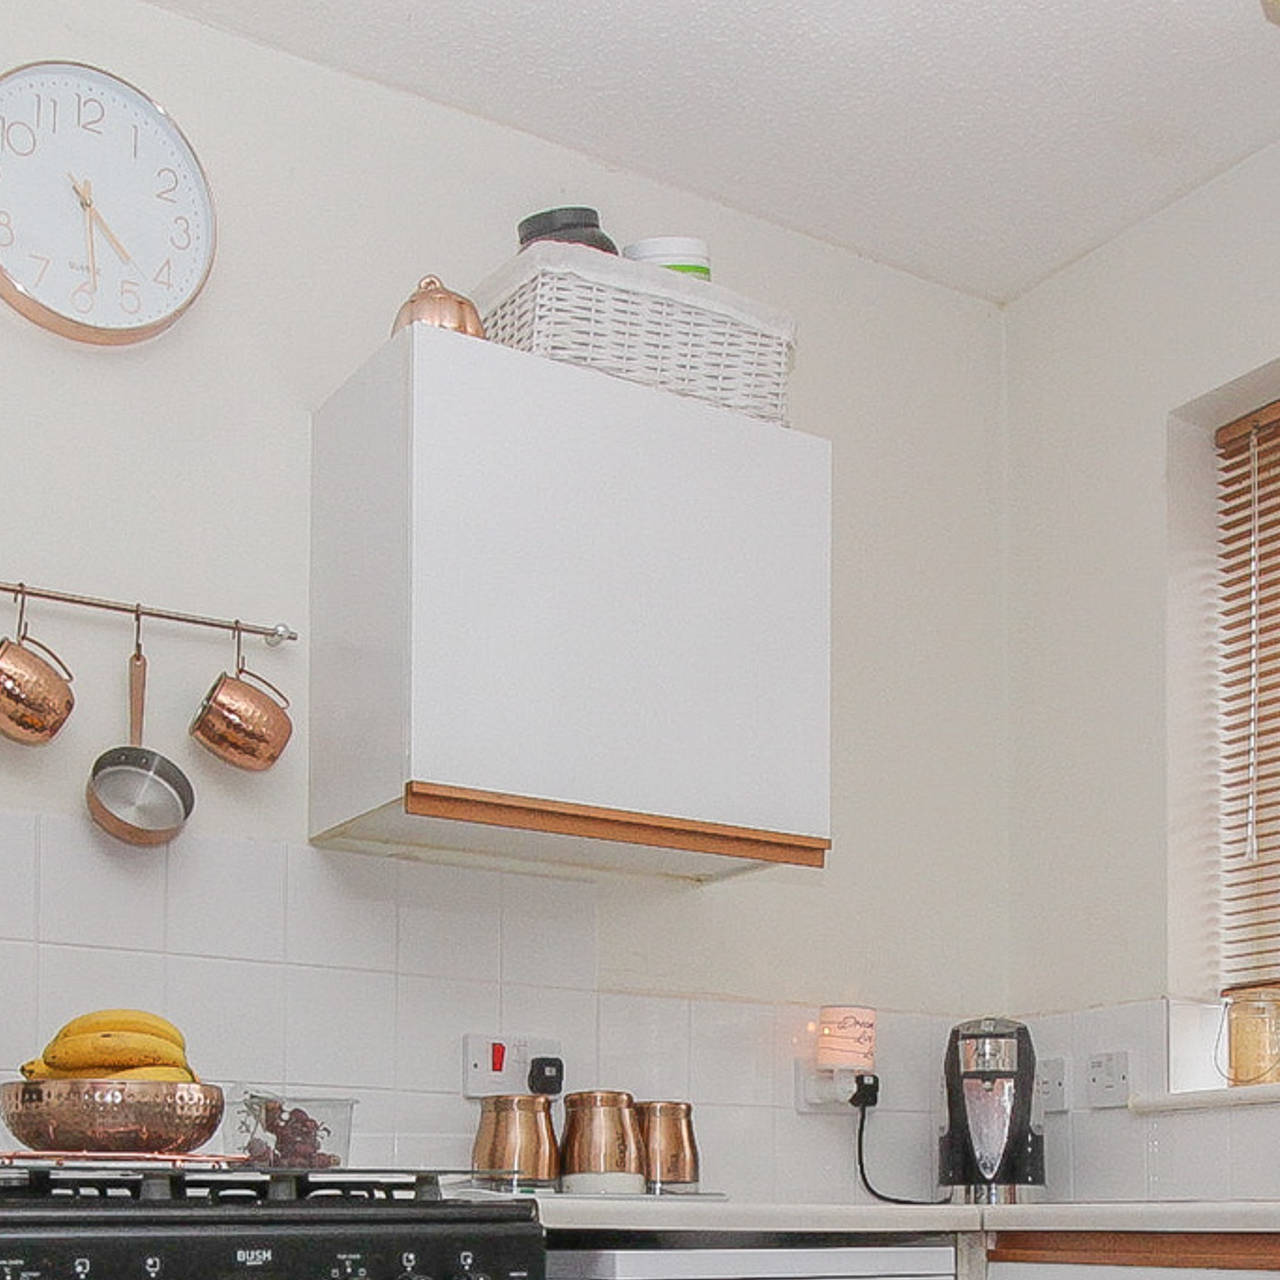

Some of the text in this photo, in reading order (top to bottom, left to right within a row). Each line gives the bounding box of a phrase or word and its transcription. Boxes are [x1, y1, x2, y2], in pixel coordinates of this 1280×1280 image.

[35, 94, 57, 134] 11
[76, 93, 106, 134] 12
[0, 116, 36, 156] 10
[131, 124, 138, 159] 1
[156, 167, 179, 203] 2
[170, 216, 191, 250] 3
[29, 254, 50, 288] 7
[153, 259, 173, 288] 4
[72, 281, 95, 314] 6
[120, 280, 141, 314] 5
[237, 1250, 272, 1262] BUSH
